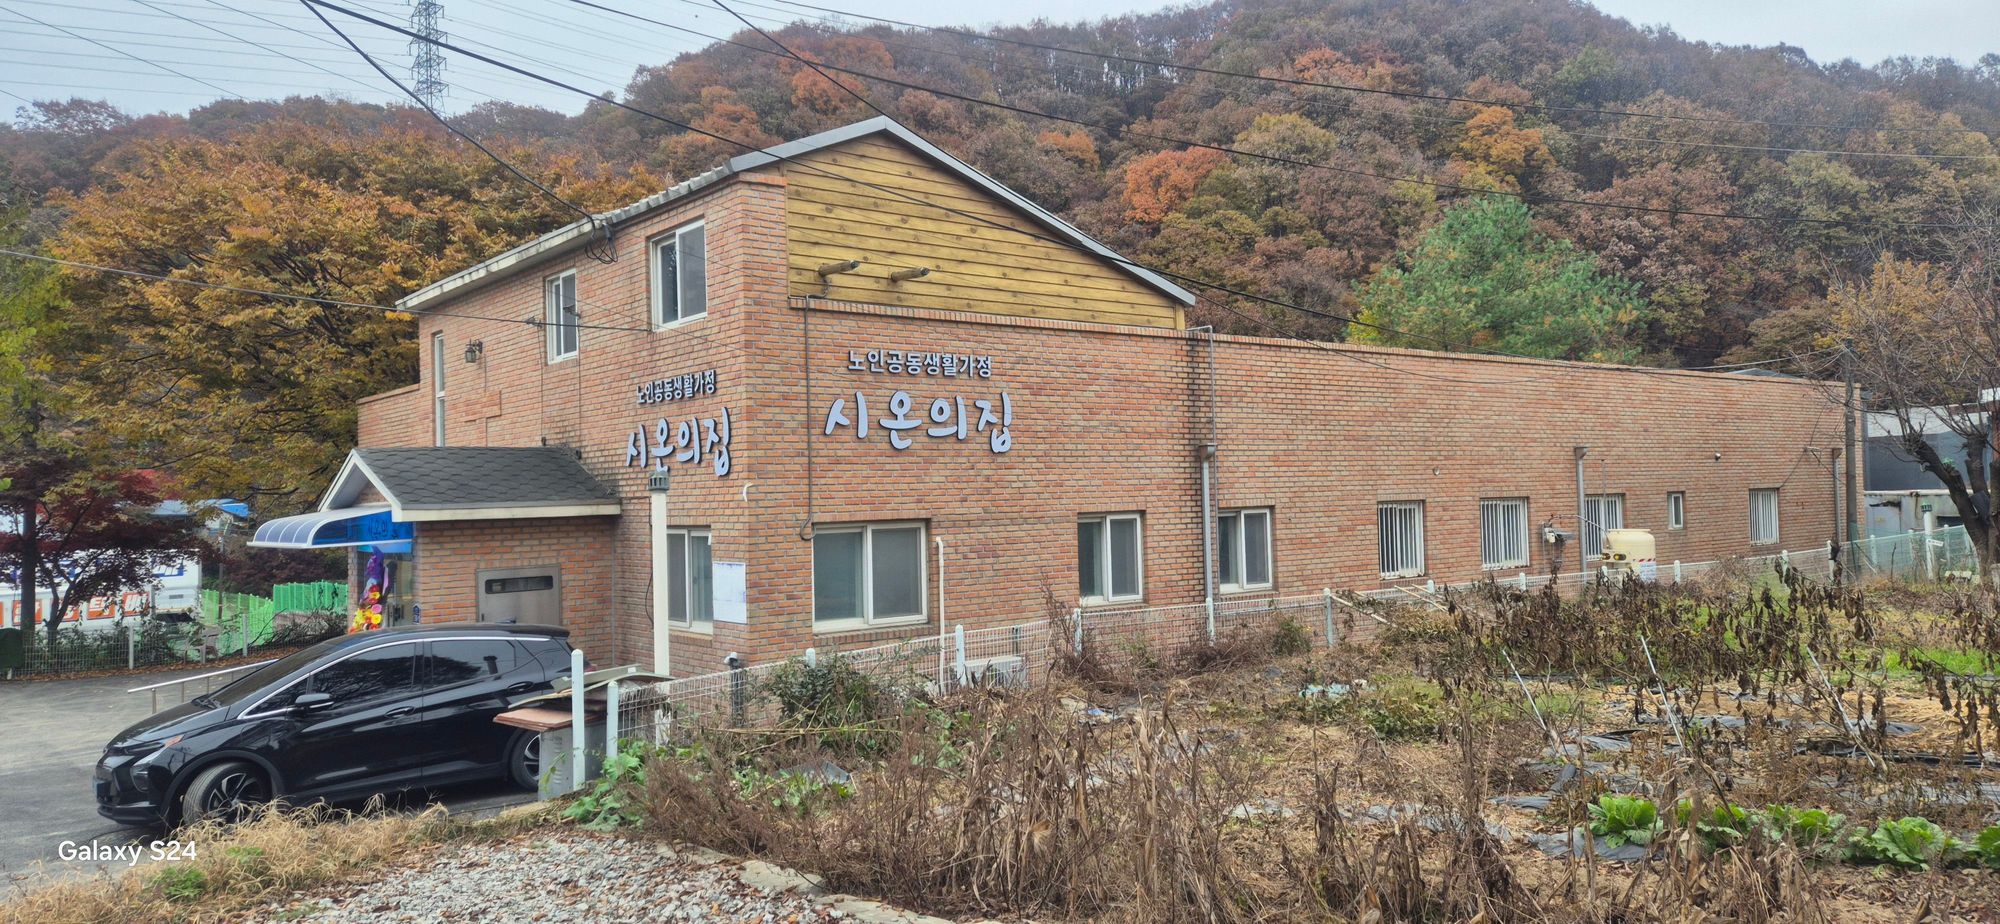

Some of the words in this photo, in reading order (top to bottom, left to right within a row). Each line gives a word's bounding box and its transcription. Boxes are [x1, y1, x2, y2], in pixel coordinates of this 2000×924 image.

[636, 369, 717, 404] 노인공동생활가정
[848, 349, 993, 379] 노인공동생활가정
[625, 406, 731, 477] 시온의집
[825, 390, 1013, 454] 시온의집
